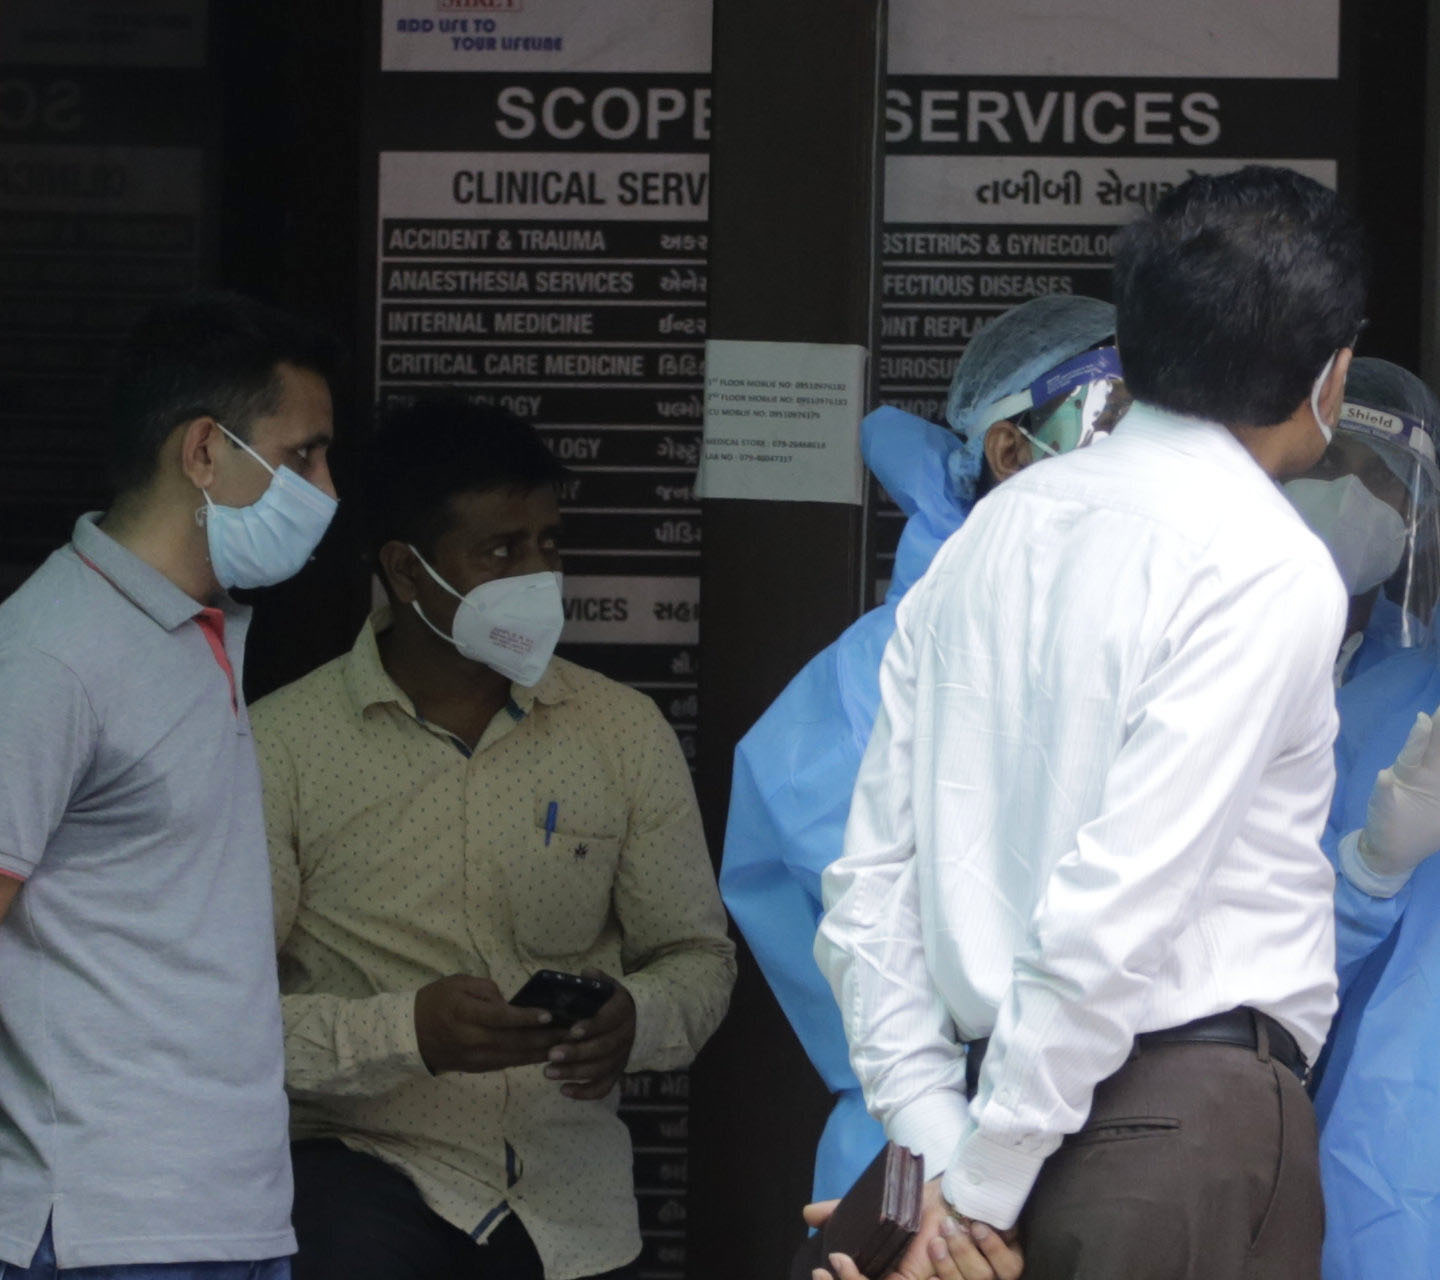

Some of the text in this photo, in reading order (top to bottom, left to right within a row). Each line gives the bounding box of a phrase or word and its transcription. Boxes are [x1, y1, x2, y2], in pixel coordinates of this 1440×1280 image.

[472, 19, 496, 33] TO
[452, 36, 496, 51] YOUR
[884, 88, 1222, 146] SERVICES
[453, 169, 605, 206] CLINICAL
[388, 228, 606, 252] ACCIDENT & TRAUMA
[986, 234, 1002, 256] &
[388, 270, 635, 294] ANAESTHESIA SERVICES
[980, 276, 1073, 297] DISEASES
[387, 312, 595, 336] INTERNAL MEDICINE
[386, 352, 645, 377] CRITICAL CARE MEDICINE
[1346, 407, 1393, 430] Shield
